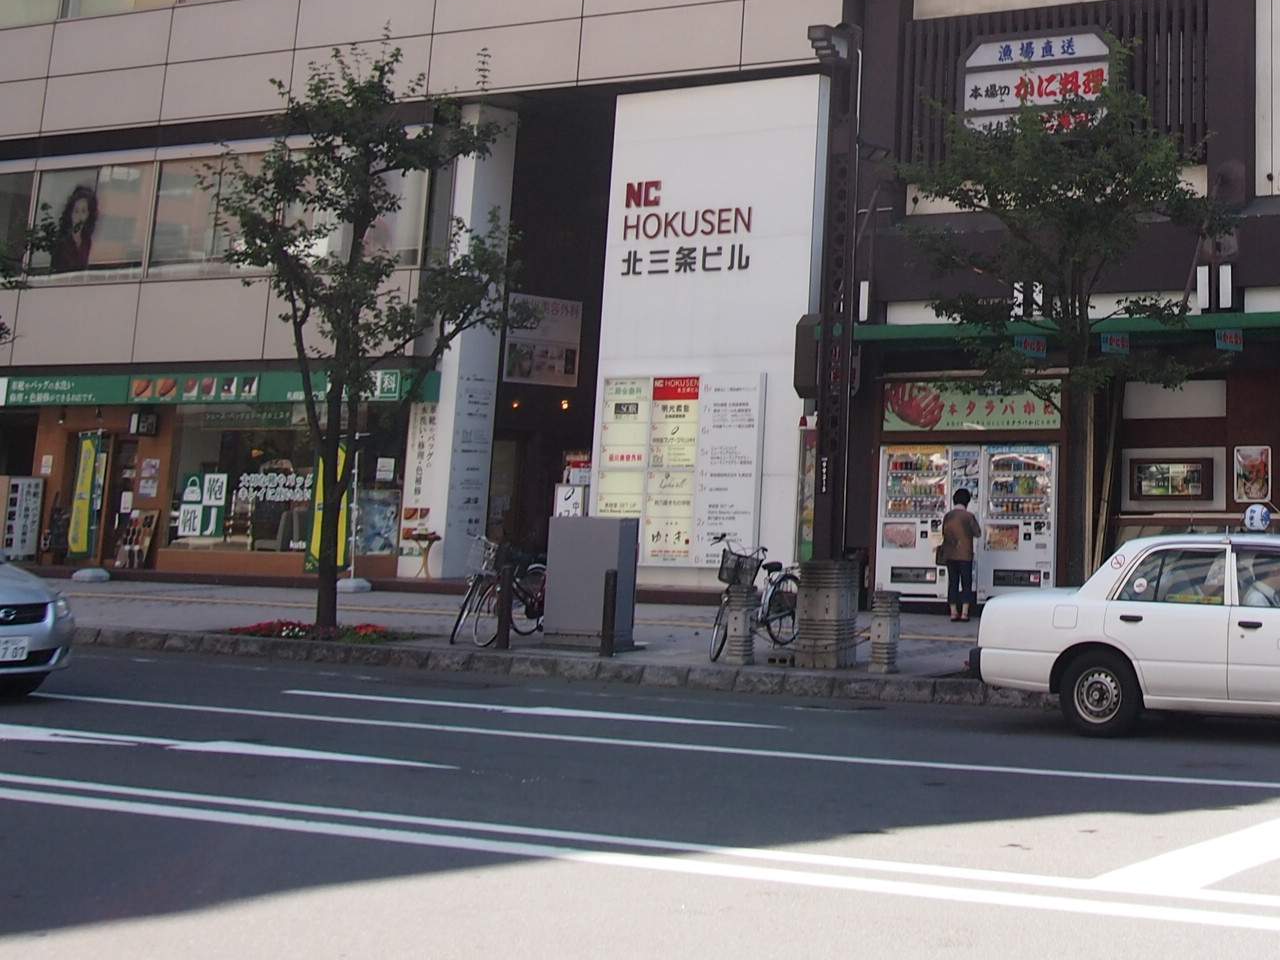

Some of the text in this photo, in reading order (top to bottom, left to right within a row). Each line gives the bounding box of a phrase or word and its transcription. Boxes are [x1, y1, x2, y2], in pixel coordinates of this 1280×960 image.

[998, 37, 1077, 62] 漁場直送
[969, 68, 1105, 103] 本場の かに料理
[625, 180, 662, 208] NC
[623, 206, 752, 241] HOKUSEN
[621, 244, 750, 276] 北三条ビル
[664, 379, 699, 388] HOKUSEN
